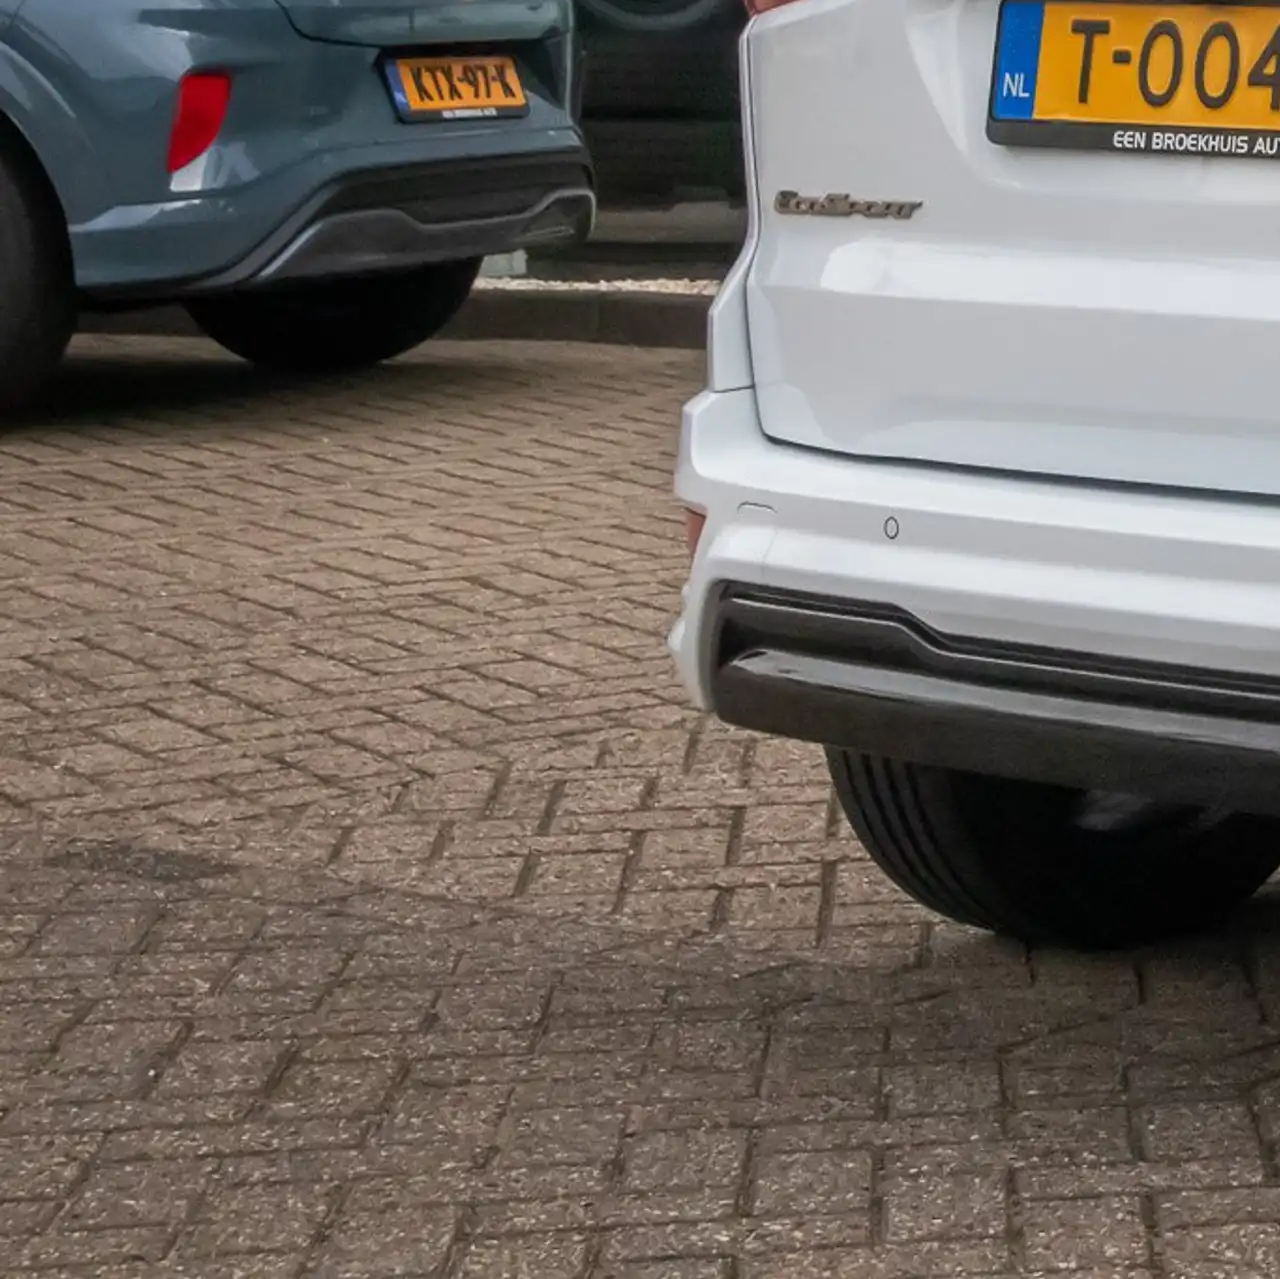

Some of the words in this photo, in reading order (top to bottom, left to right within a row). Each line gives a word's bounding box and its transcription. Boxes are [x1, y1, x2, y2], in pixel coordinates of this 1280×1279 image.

[410, 63, 516, 102] KTX-97-K
[1002, 71, 1031, 98] NL
[1113, 130, 1147, 149] EEN
[1152, 132, 1249, 154] BROEKHUIS
